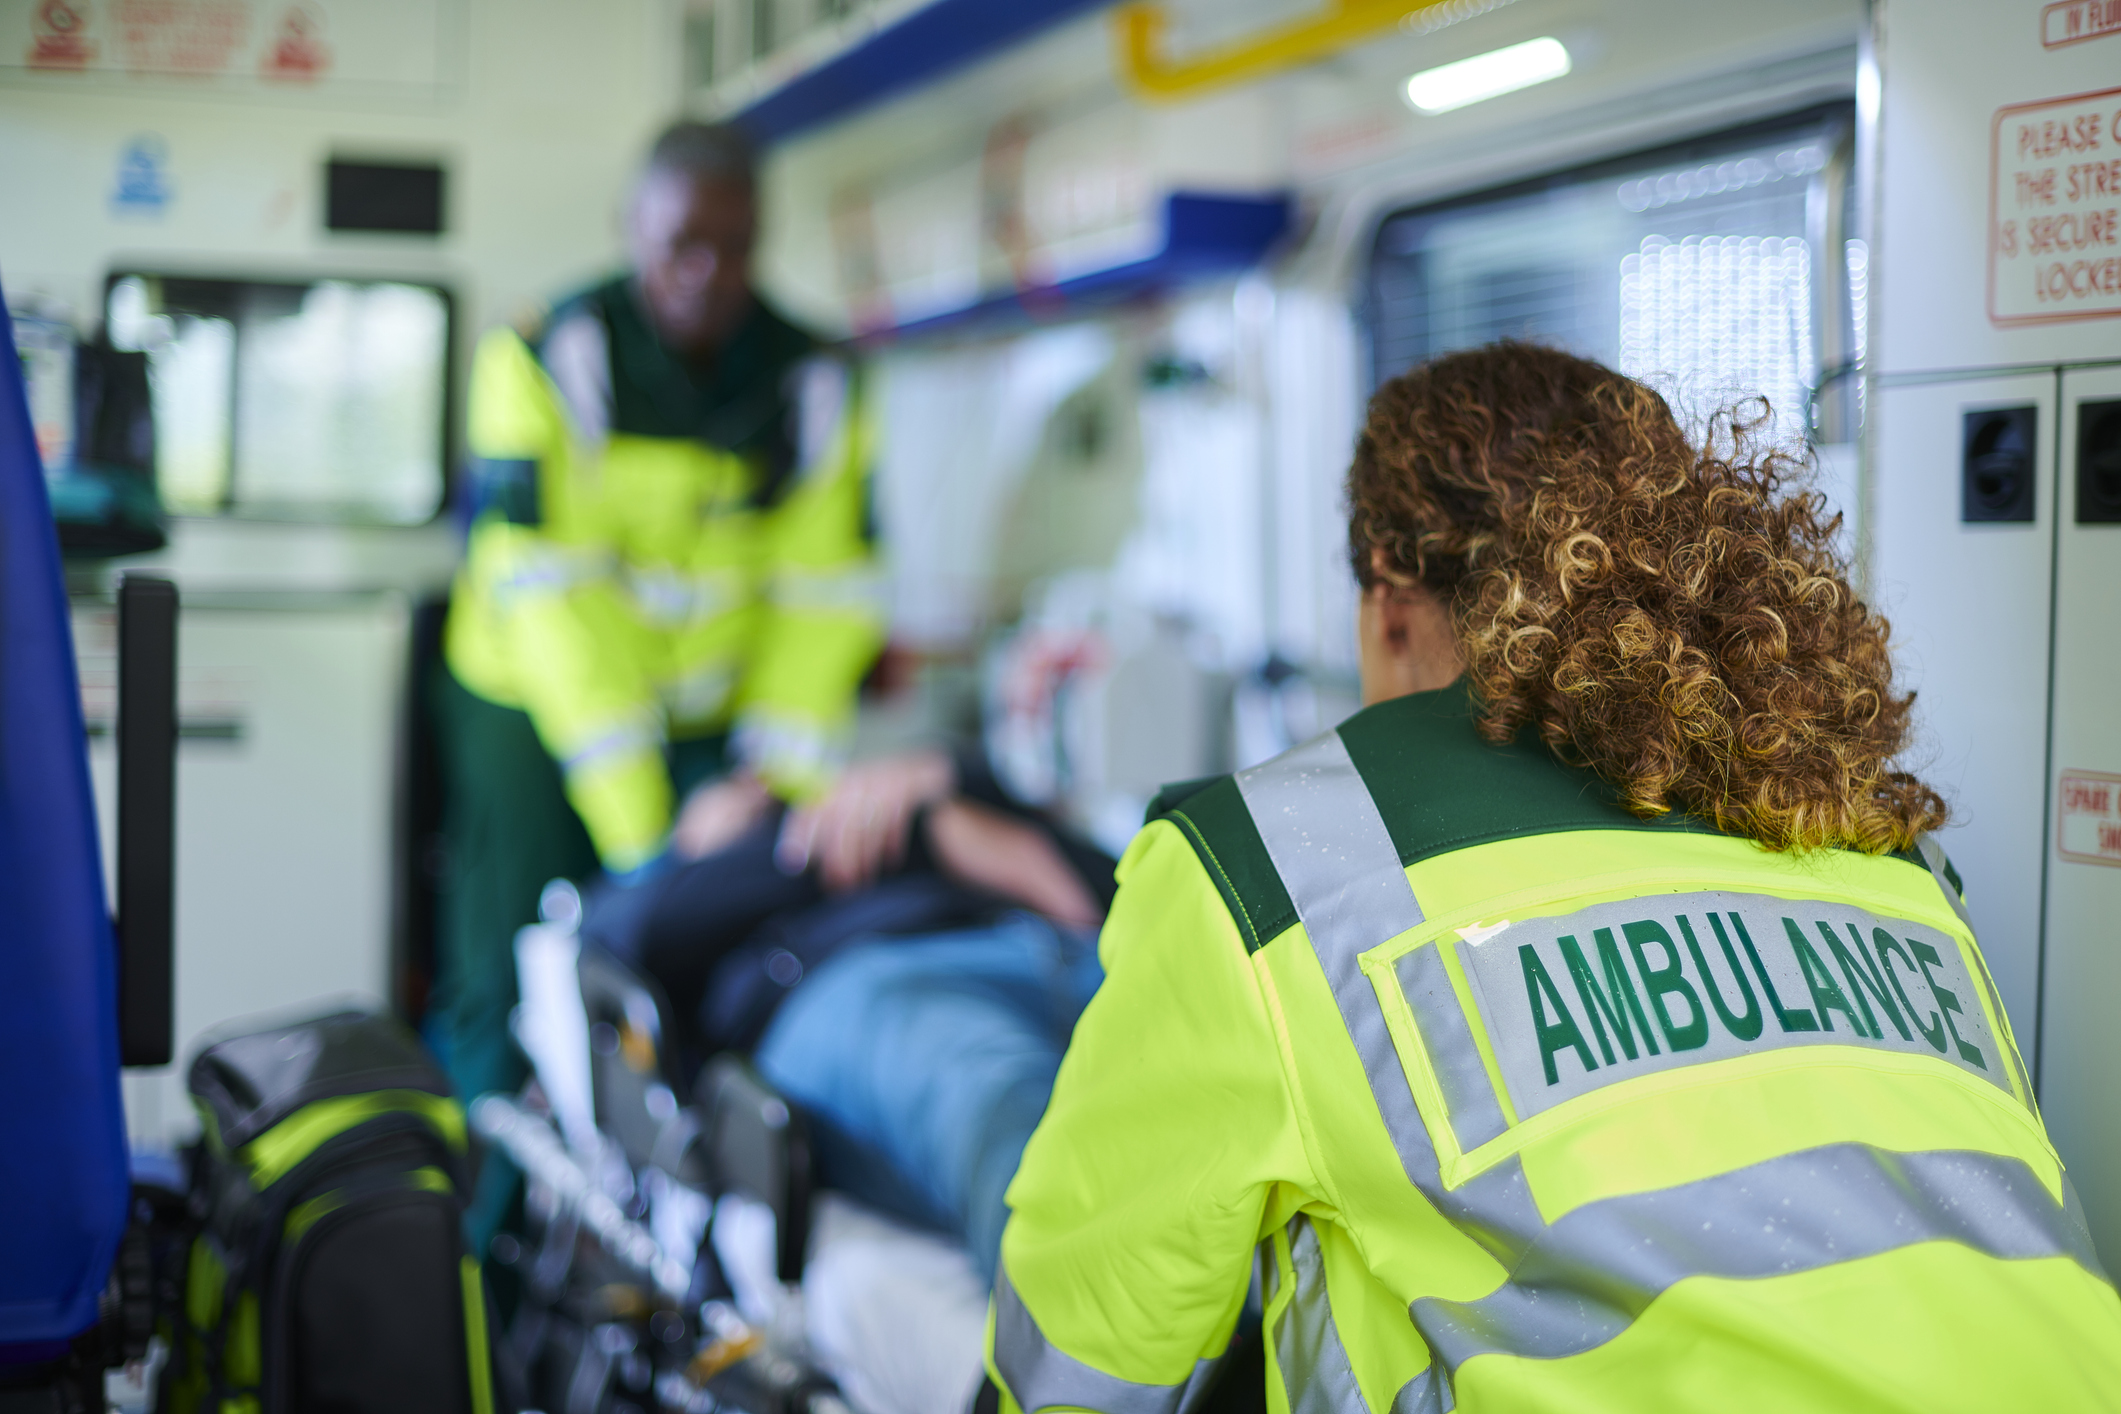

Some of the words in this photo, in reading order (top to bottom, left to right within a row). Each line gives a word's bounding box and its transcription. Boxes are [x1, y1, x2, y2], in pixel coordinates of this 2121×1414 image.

[2018, 113, 2102, 162] PLEASE
[2014, 167, 2057, 208] THE
[2027, 208, 2118, 257] SECURE
[2035, 257, 2121, 303] LOCKE
[1517, 911, 1988, 1086] AMBULANCE
